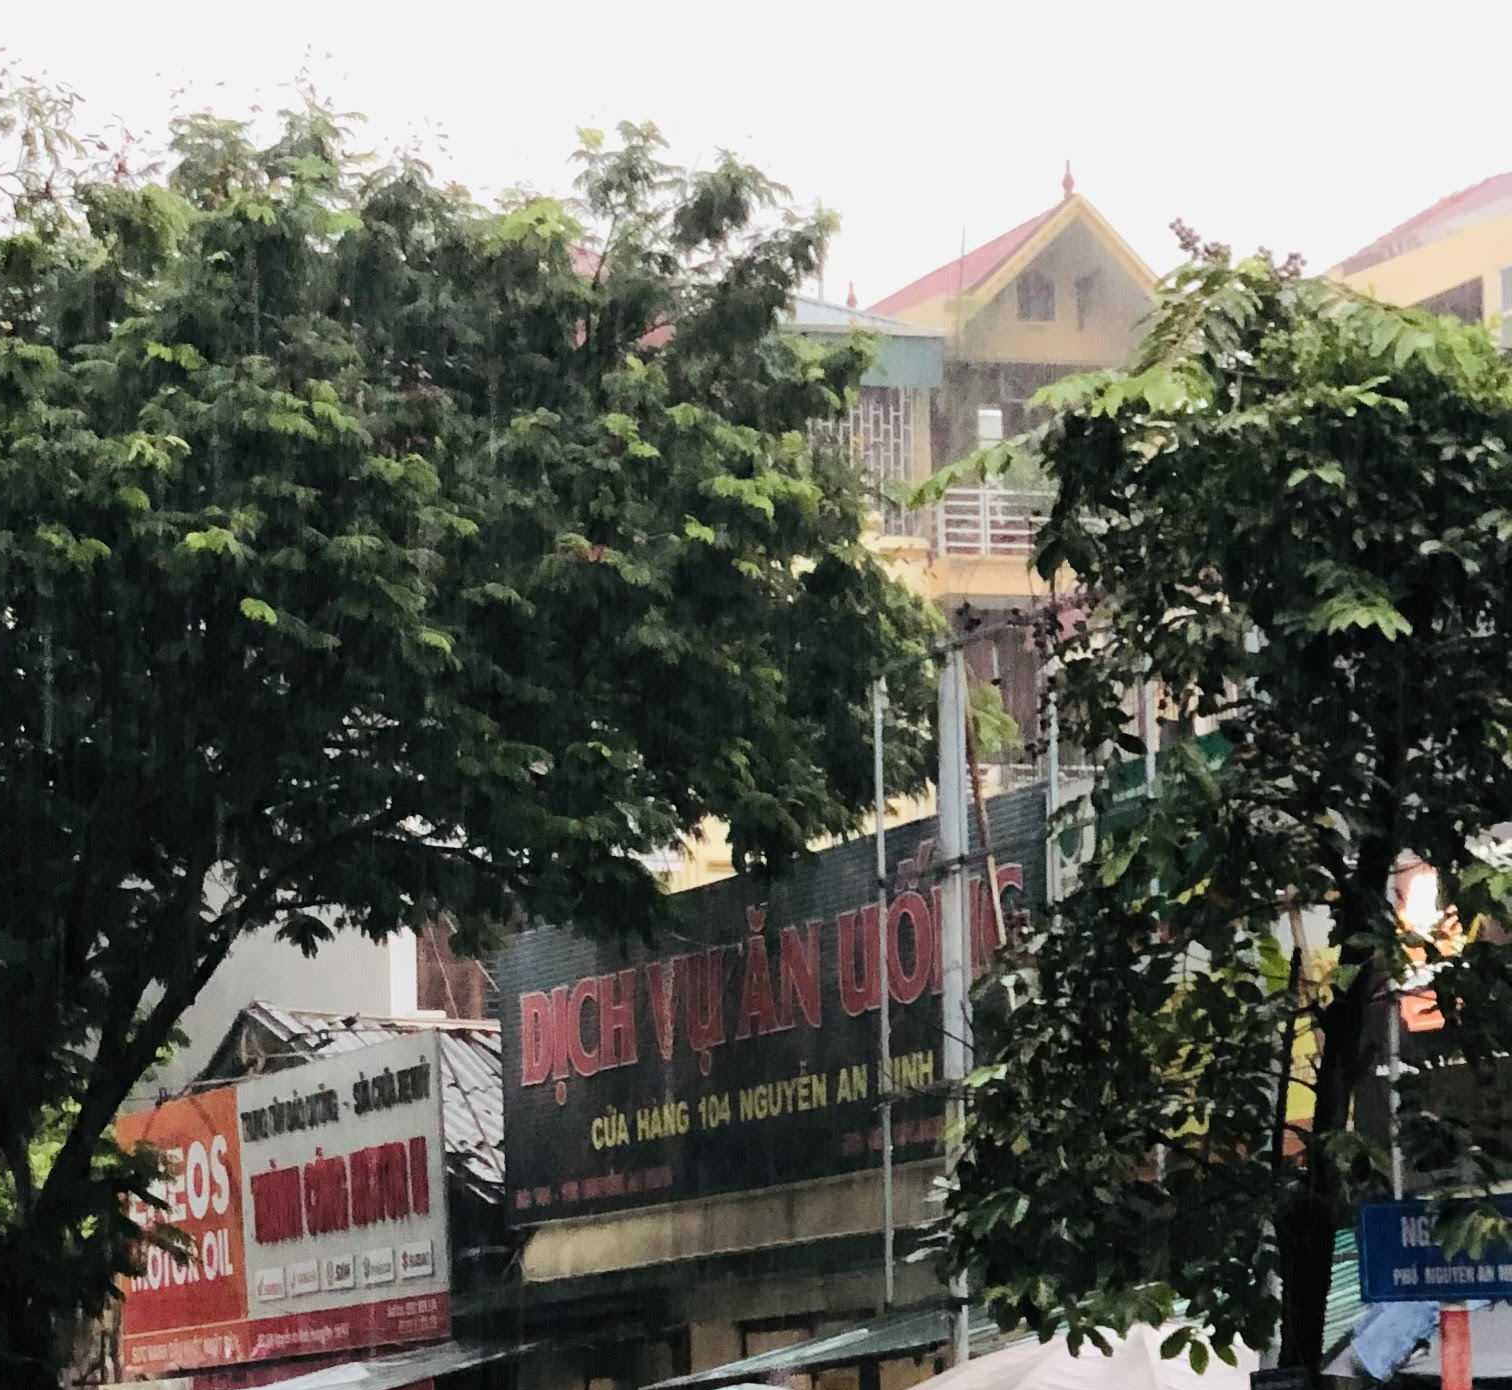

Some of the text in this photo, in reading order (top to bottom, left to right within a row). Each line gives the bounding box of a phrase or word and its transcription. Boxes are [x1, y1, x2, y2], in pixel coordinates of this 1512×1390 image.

[520, 967, 639, 1106] DỊCH
[645, 948, 726, 1077] VỤ
[736, 902, 825, 1041] ĂN
[698, 1091, 731, 1130] 104
[837, 1064, 868, 1104] AN
[202, 1228, 233, 1281] OIL
